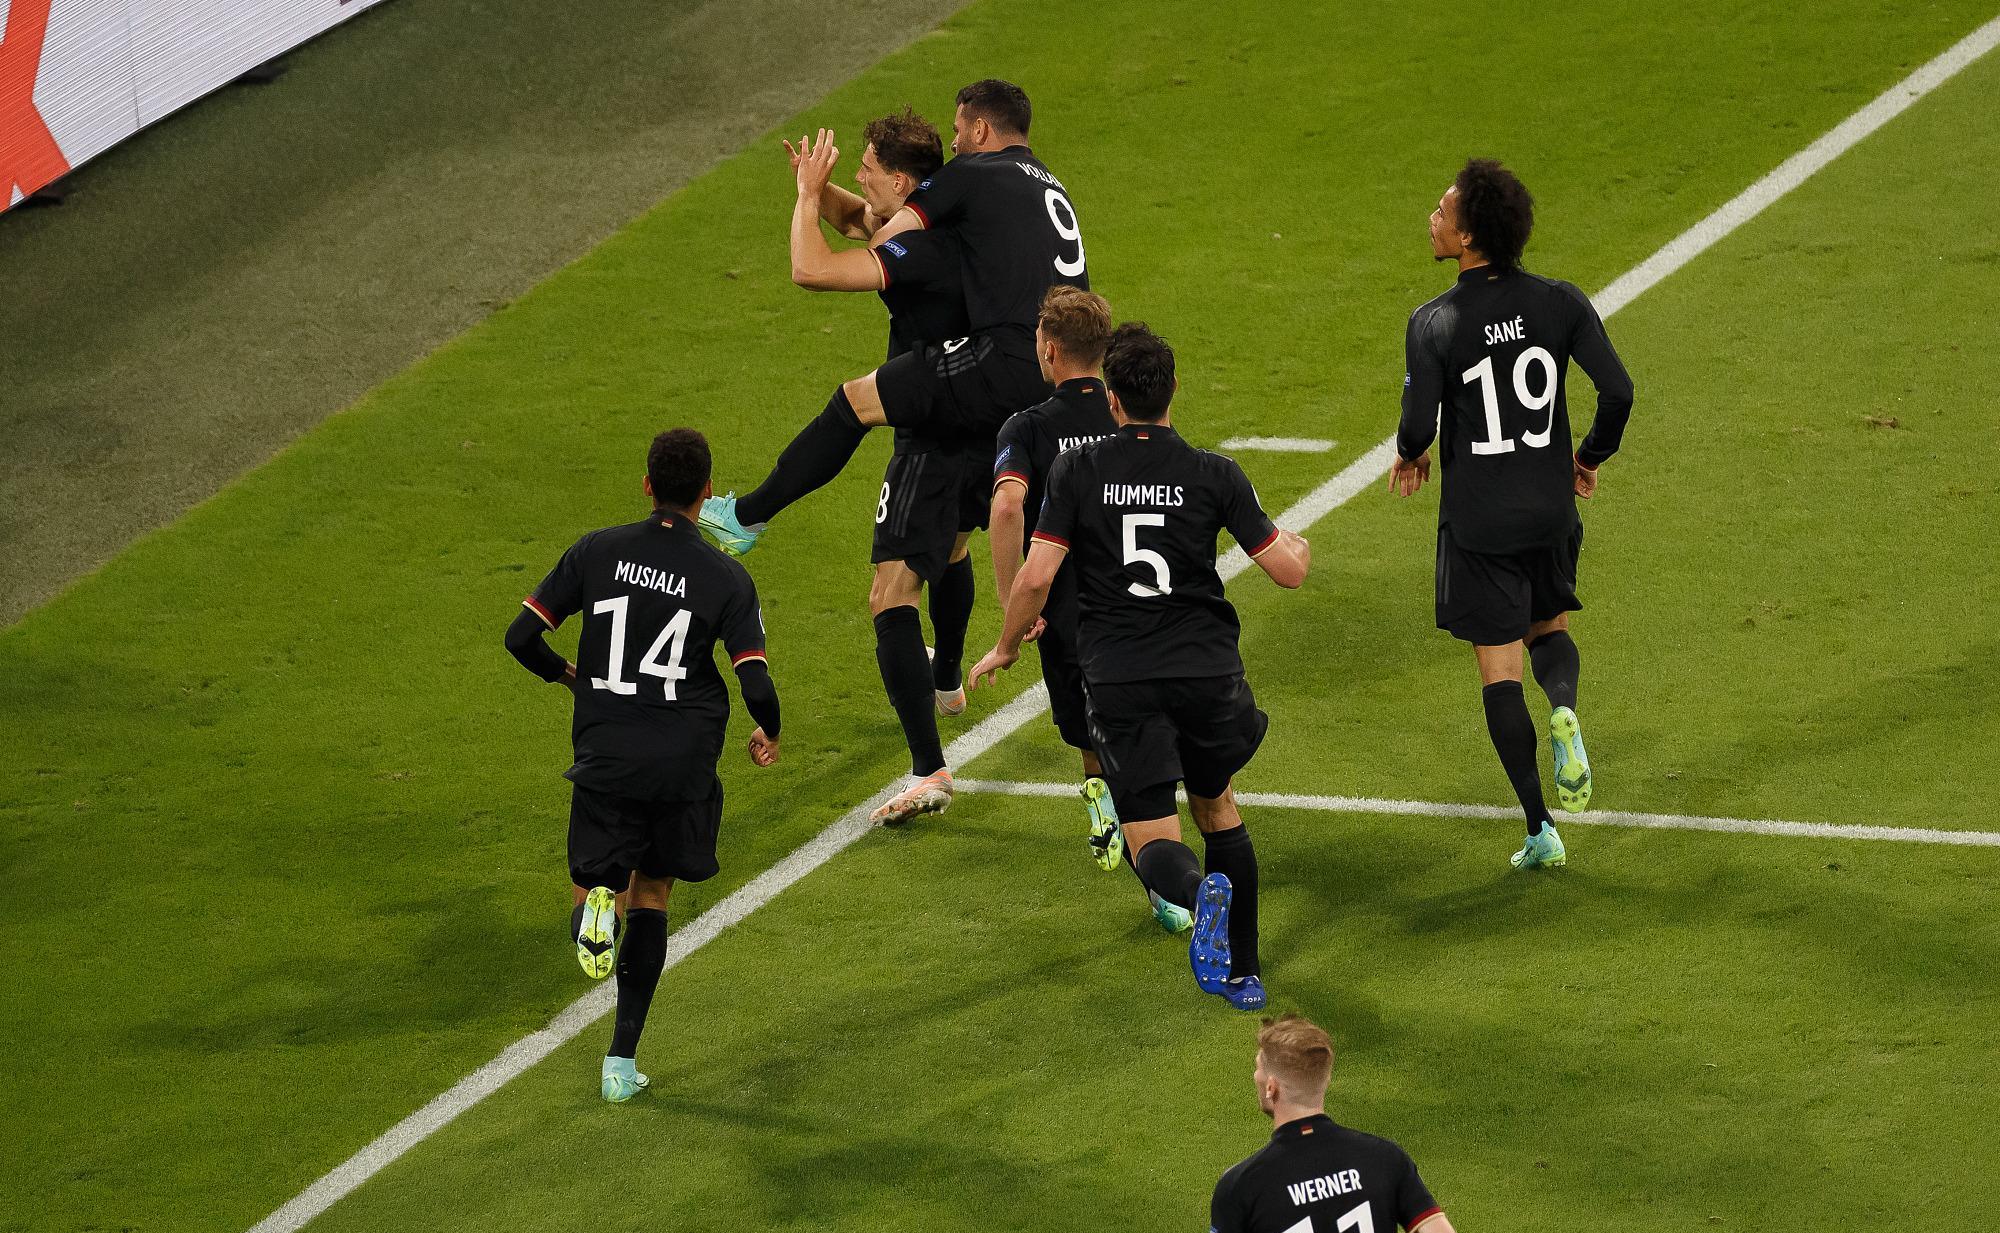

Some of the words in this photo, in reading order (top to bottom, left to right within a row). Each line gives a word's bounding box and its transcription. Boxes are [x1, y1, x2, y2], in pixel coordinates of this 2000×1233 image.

[1044, 188, 1086, 277] 9
[1484, 315, 1526, 345] SANÉ
[1462, 346, 1558, 455] 19
[875, 481, 890, 524] 8
[1103, 483, 1184, 507] HUMMELS
[1122, 513, 1173, 597] 5
[614, 560, 687, 599] MUSIALA
[591, 595, 692, 701] 14
[1286, 1168, 1363, 1206] WERNER
